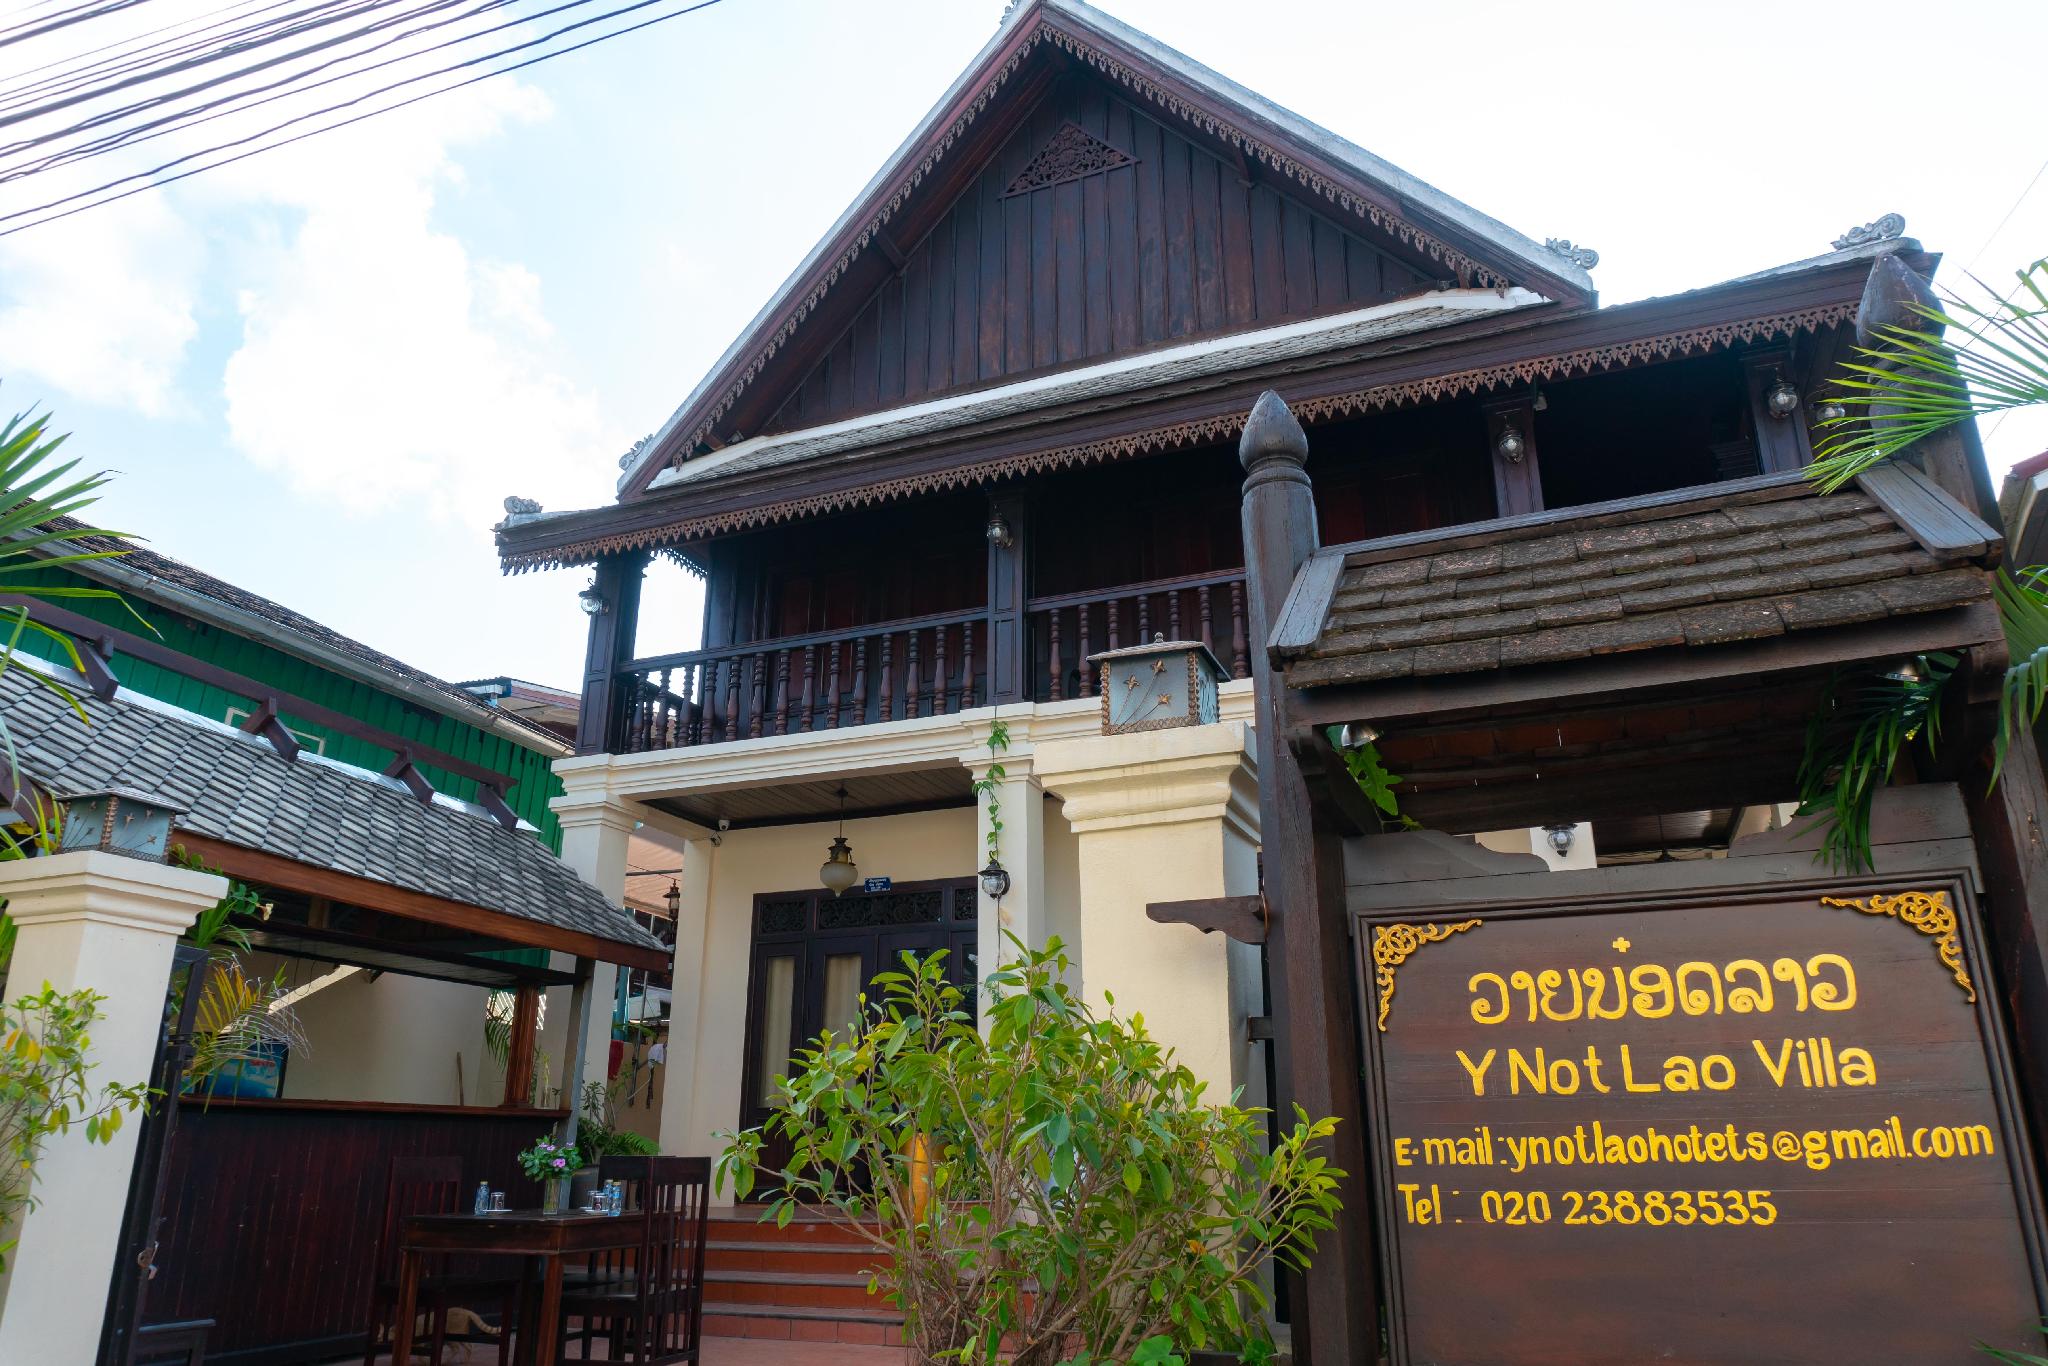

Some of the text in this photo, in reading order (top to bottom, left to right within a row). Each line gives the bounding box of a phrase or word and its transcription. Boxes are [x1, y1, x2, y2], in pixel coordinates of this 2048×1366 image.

[1455, 1036, 1878, 1097] Y Not Lao Villa
[1480, 1190, 1552, 1226] 020
[1561, 1189, 1778, 1226] 23883535
